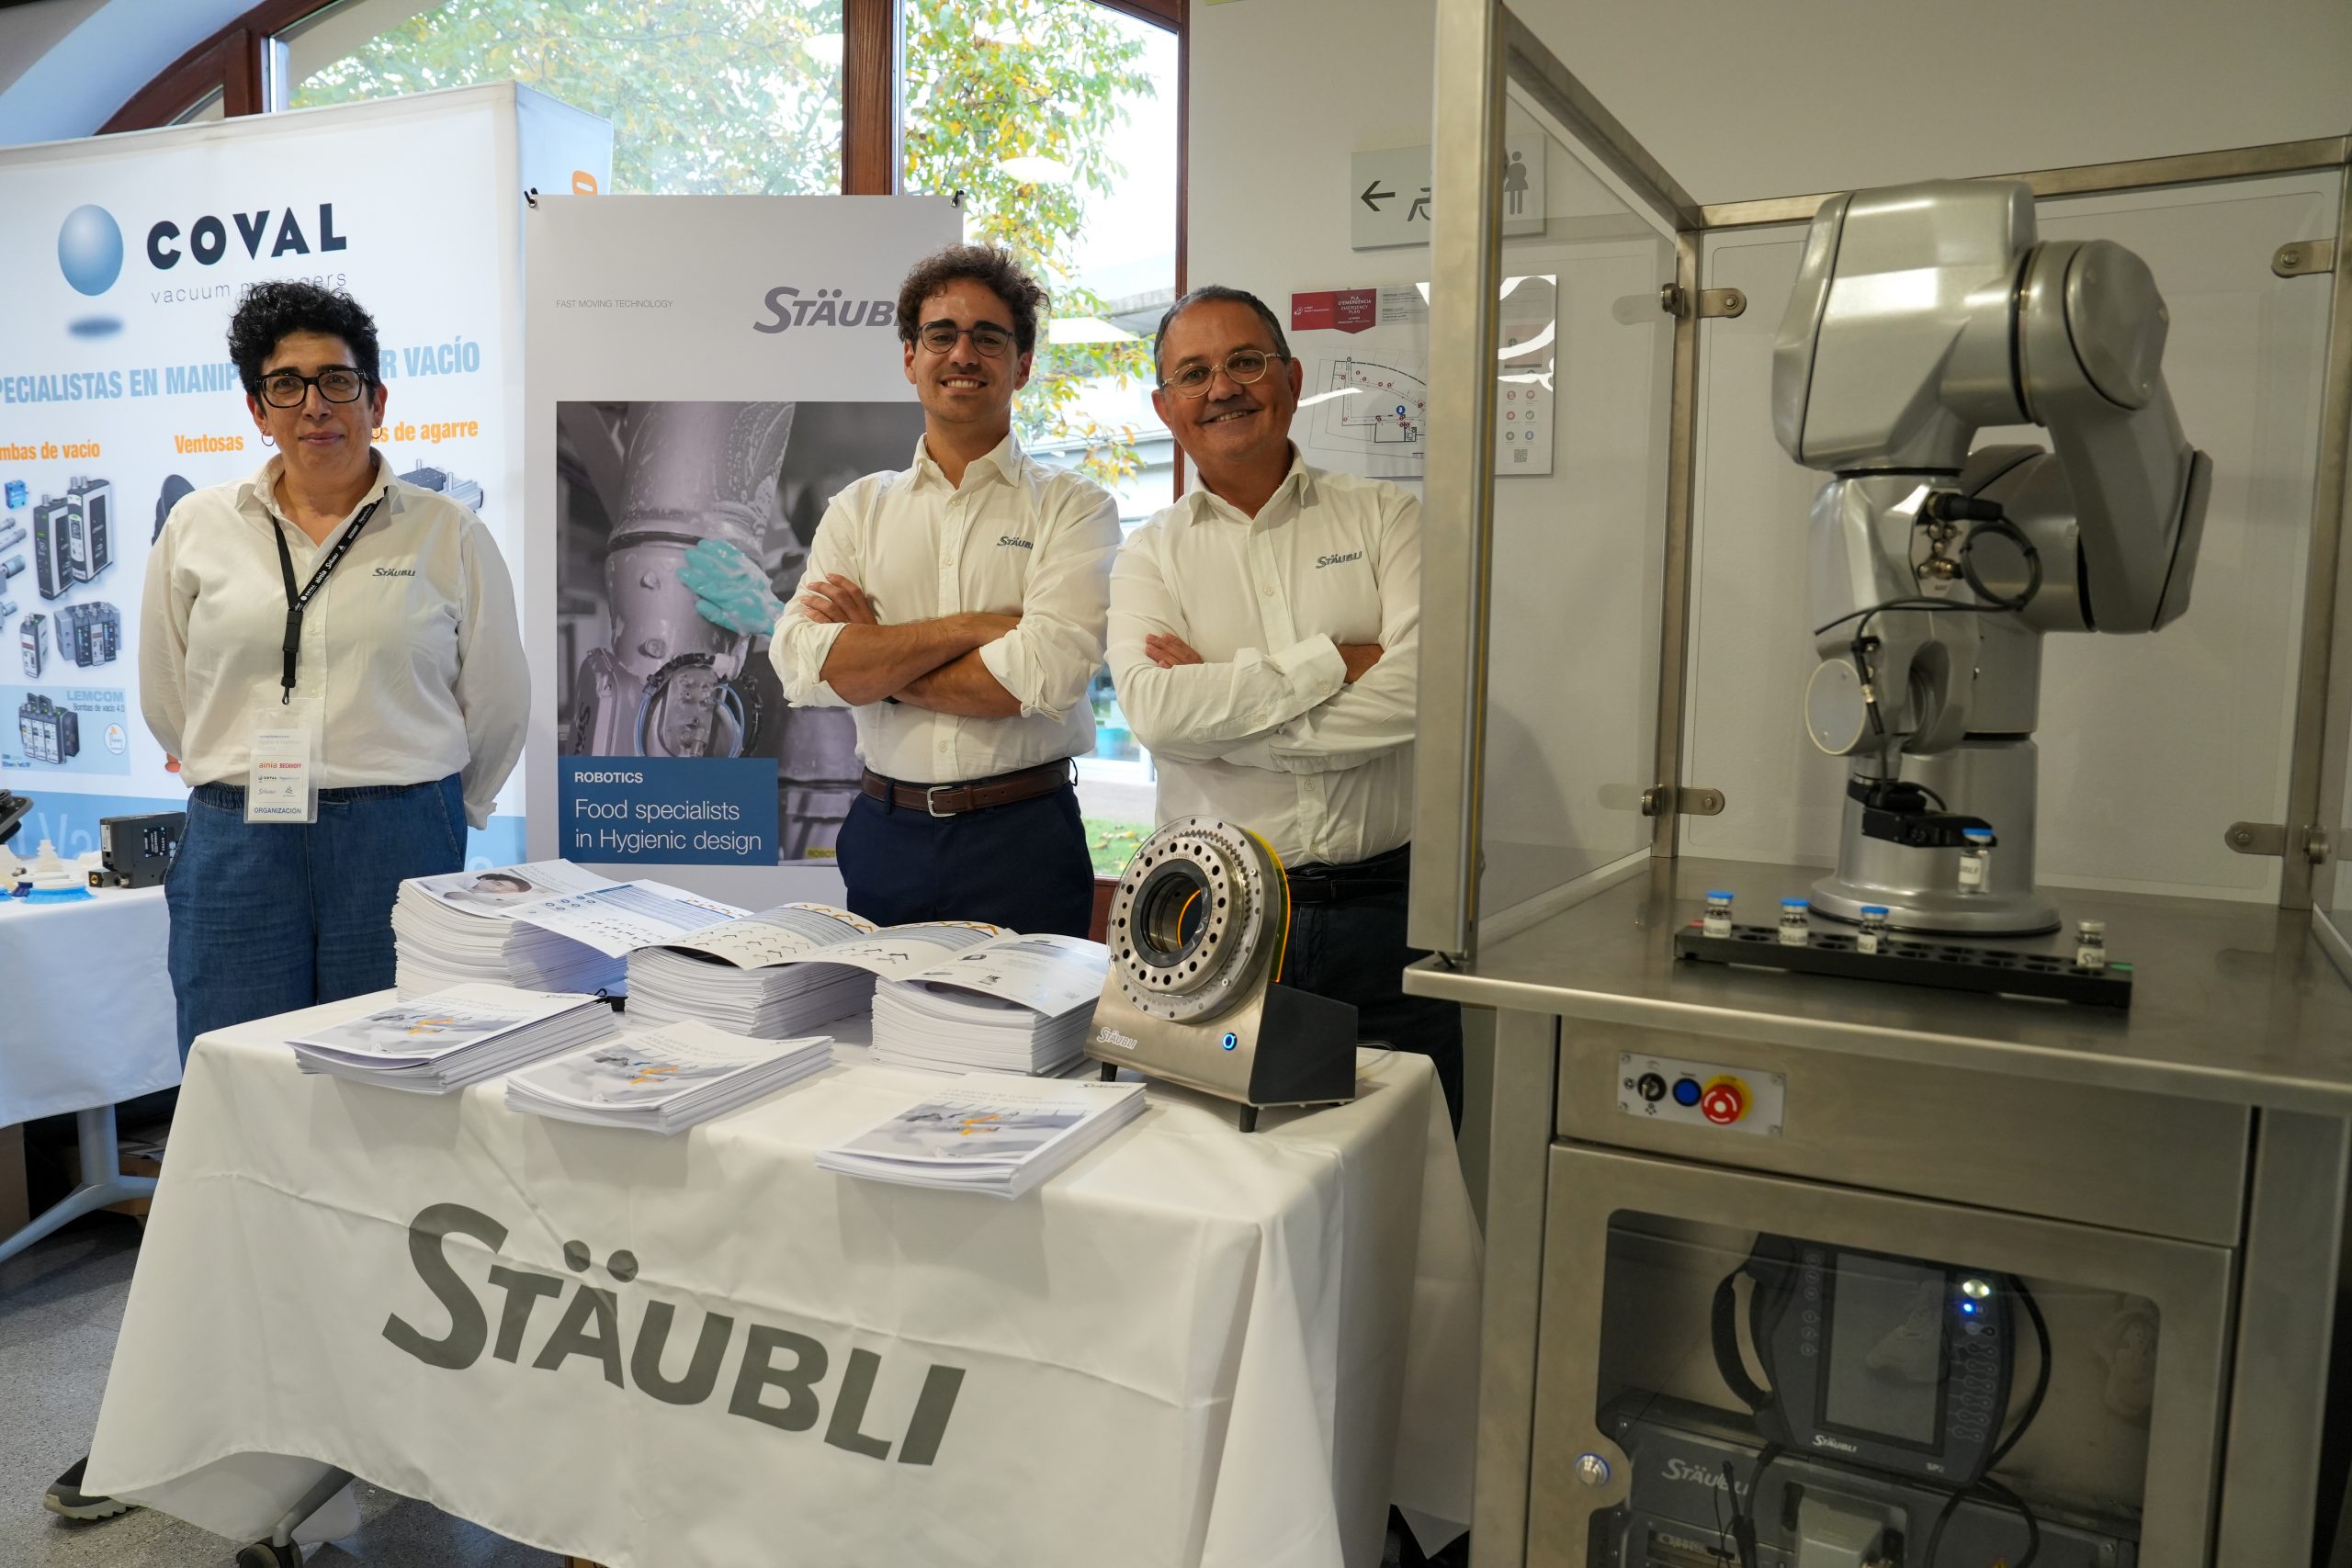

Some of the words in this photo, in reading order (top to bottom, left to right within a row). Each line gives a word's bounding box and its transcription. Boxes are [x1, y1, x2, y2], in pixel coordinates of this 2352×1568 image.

[147, 203, 346, 270] COVAL
[152, 284, 231, 304] vacuum
[556, 299, 576, 308] FAST
[579, 299, 613, 308] MOVING
[615, 299, 673, 308] TECHNOLOGY
[753, 287, 900, 333] STÄUB
[130, 368, 158, 397] EN
[403, 334, 481, 378] VACÍO
[394, 421, 416, 442] de
[421, 420, 479, 445] agarre
[40, 441, 59, 459] de
[175, 434, 244, 454] Ventosas
[1316, 550, 1363, 569] STÄUBLI
[372, 568, 416, 577] STÄUBLI
[67, 690, 124, 703] LEMCOM
[574, 772, 643, 784] ROBOTICS
[254, 807, 302, 815] ORGANIZACIÓN
[575, 798, 628, 819] Food
[635, 800, 741, 823] specialists
[575, 829, 593, 848] in
[600, 829, 686, 853] Hygienic
[694, 830, 762, 855] design
[1096, 1026, 1137, 1050] STÄUBLI
[382, 1202, 967, 1466] STÄUBLI
[1812, 1434, 1858, 1453] STÄUBLI
